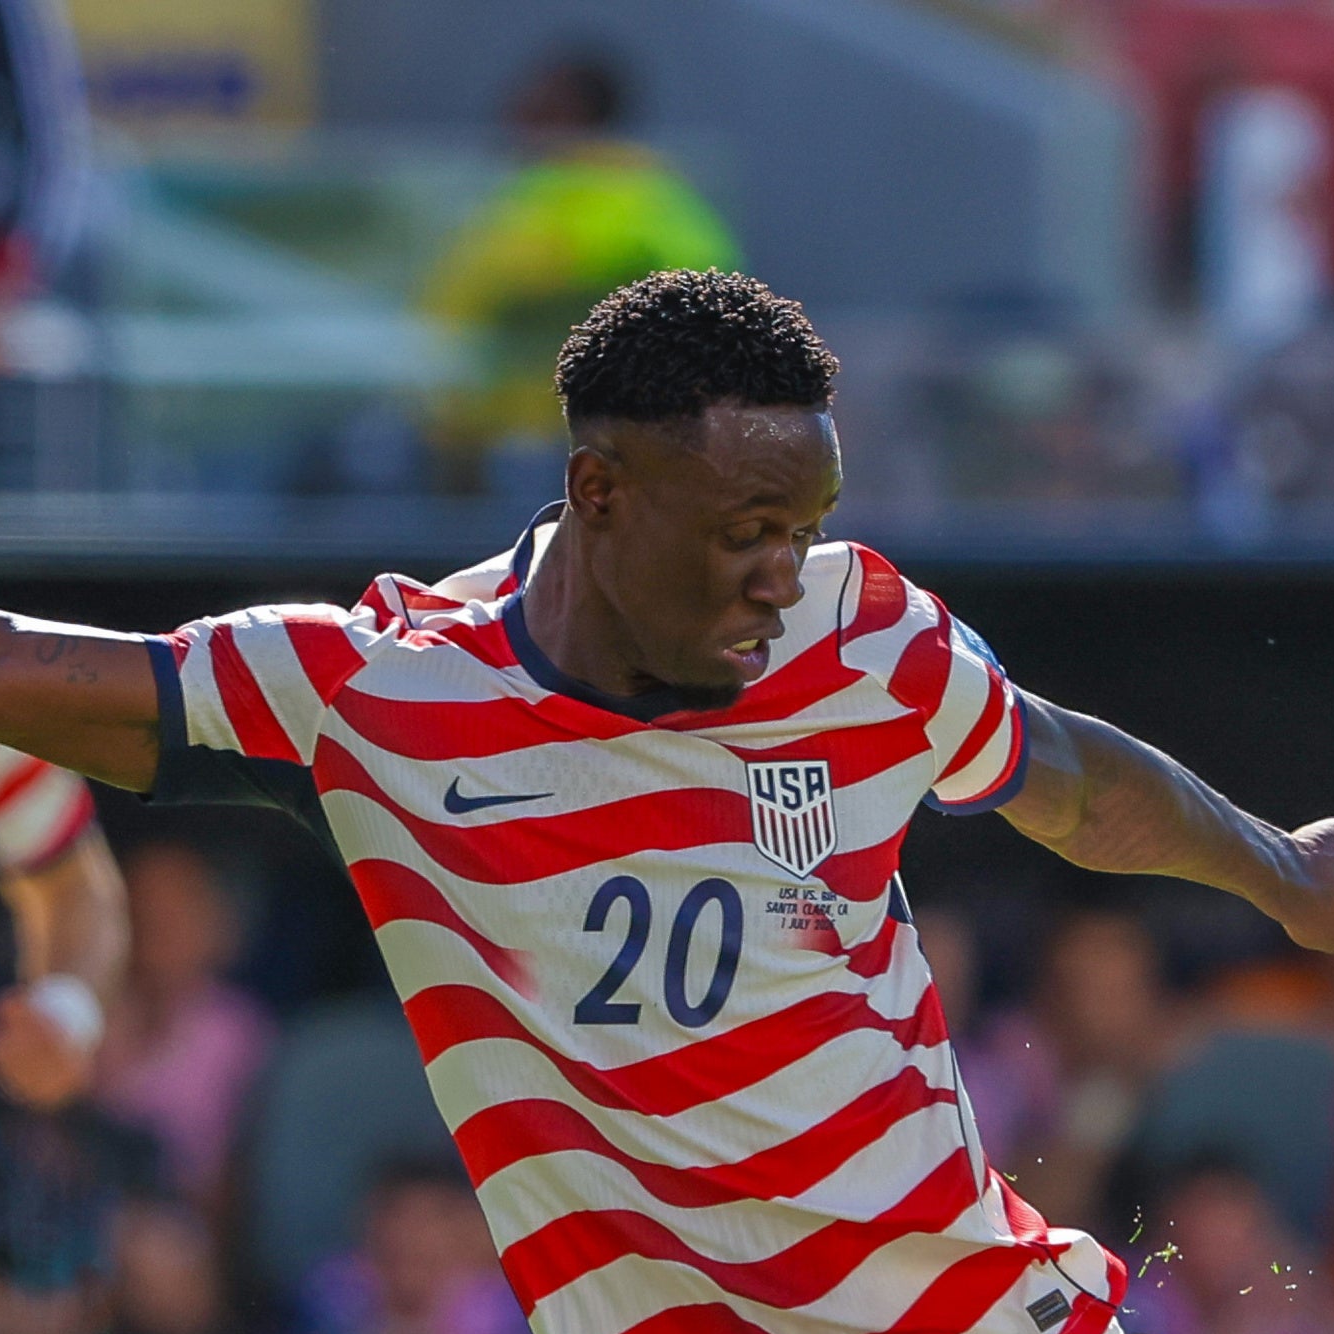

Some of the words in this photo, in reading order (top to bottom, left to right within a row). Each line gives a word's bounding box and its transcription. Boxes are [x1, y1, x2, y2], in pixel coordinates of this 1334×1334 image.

[753, 766, 826, 811] USA
[778, 887, 798, 900] USA
[803, 889, 818, 901] VS.
[765, 901, 798, 915] SANTA
[837, 903, 849, 916] CA
[781, 917, 786, 929] 1
[789, 918, 810, 930] JULY
[573, 875, 745, 1029] 20
